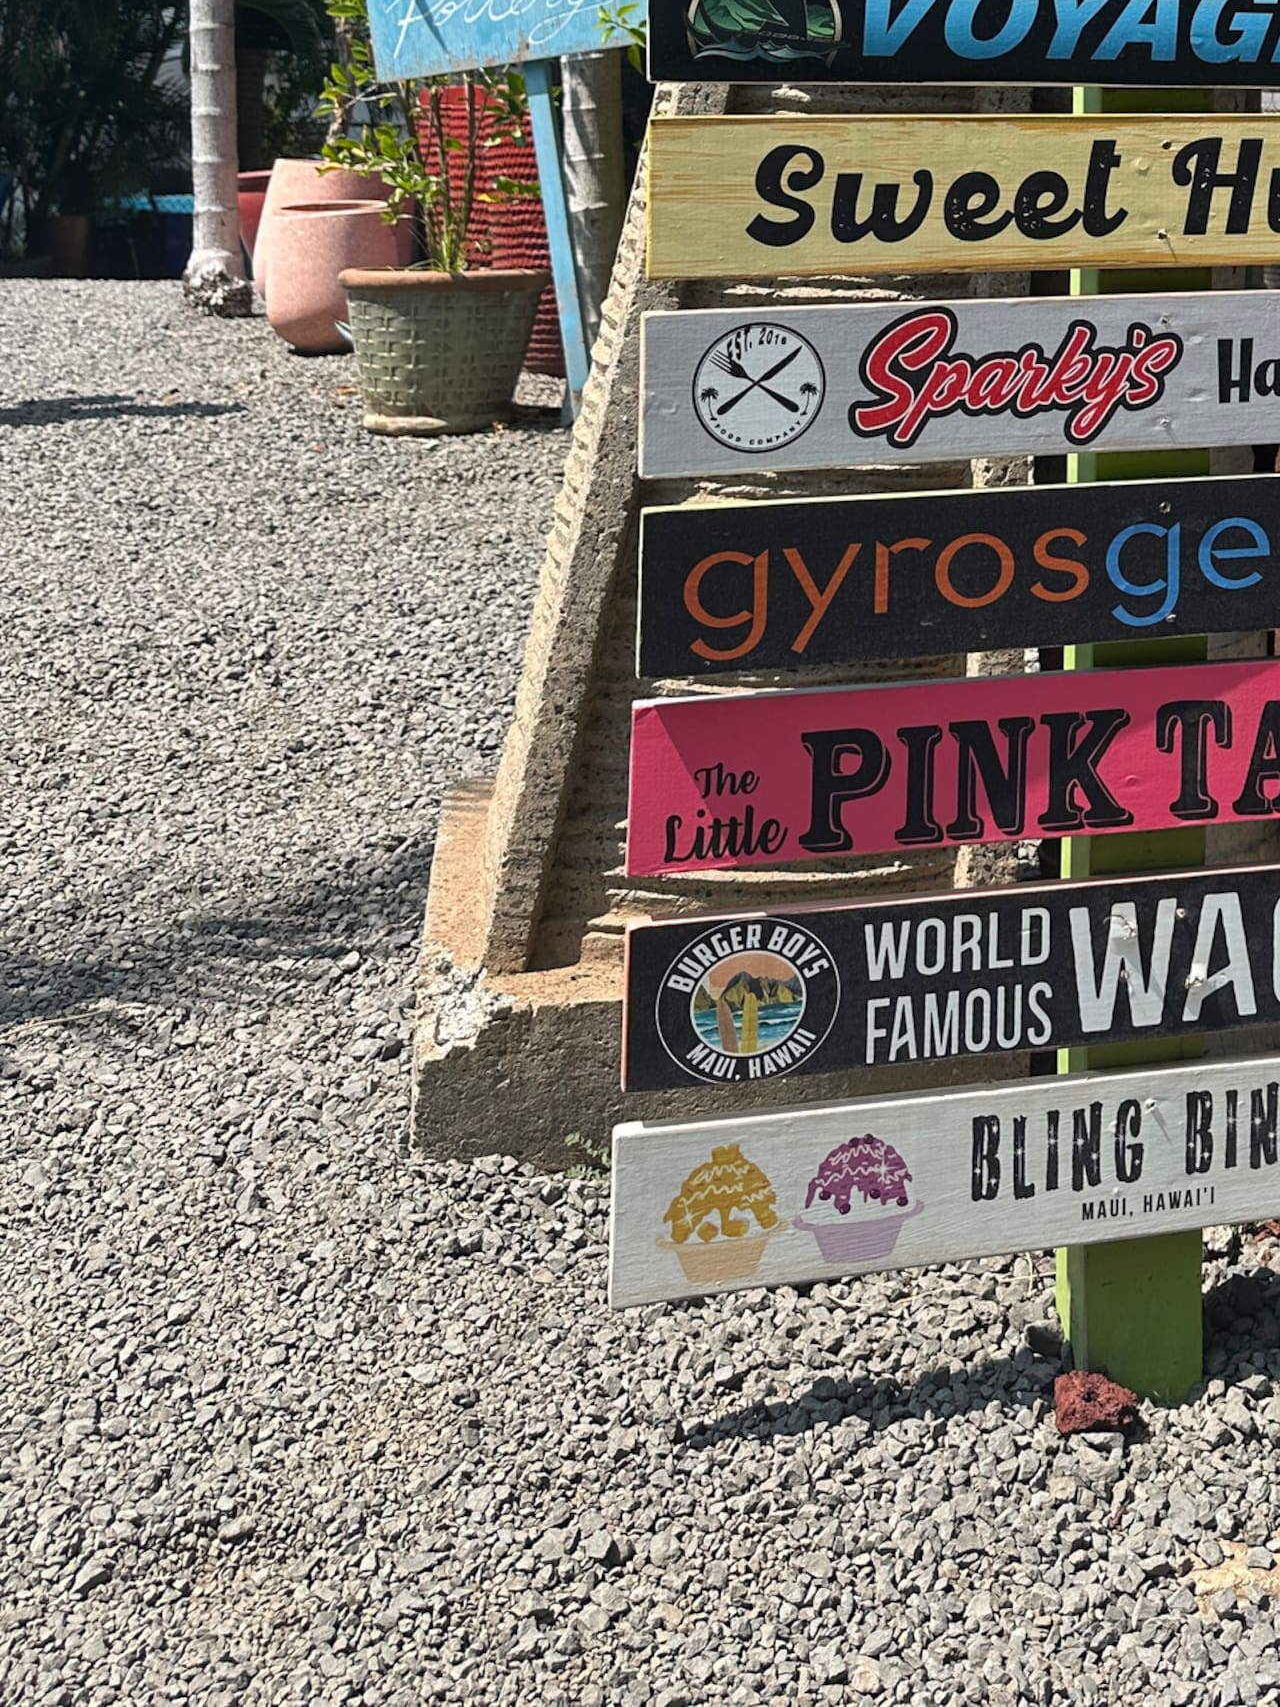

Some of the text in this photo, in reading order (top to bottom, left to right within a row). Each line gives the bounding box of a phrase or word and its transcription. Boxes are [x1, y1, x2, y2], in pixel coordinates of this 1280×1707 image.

[746, 138, 1128, 248] Sweet
[849, 306, 1183, 449] Sparky's
[694, 761, 760, 800] The
[798, 707, 1136, 854] PINK
[663, 806, 787, 864] Little
[667, 924, 830, 993] BURGER BOYS
[864, 905, 1052, 982] WORLD
[686, 1028, 817, 1081] MAUI, HAWAII
[864, 982, 1053, 1065] FAMOUS
[969, 1098, 1144, 1202] BLING
[1082, 1186, 1214, 1220] MAUI, HAWAI'I
